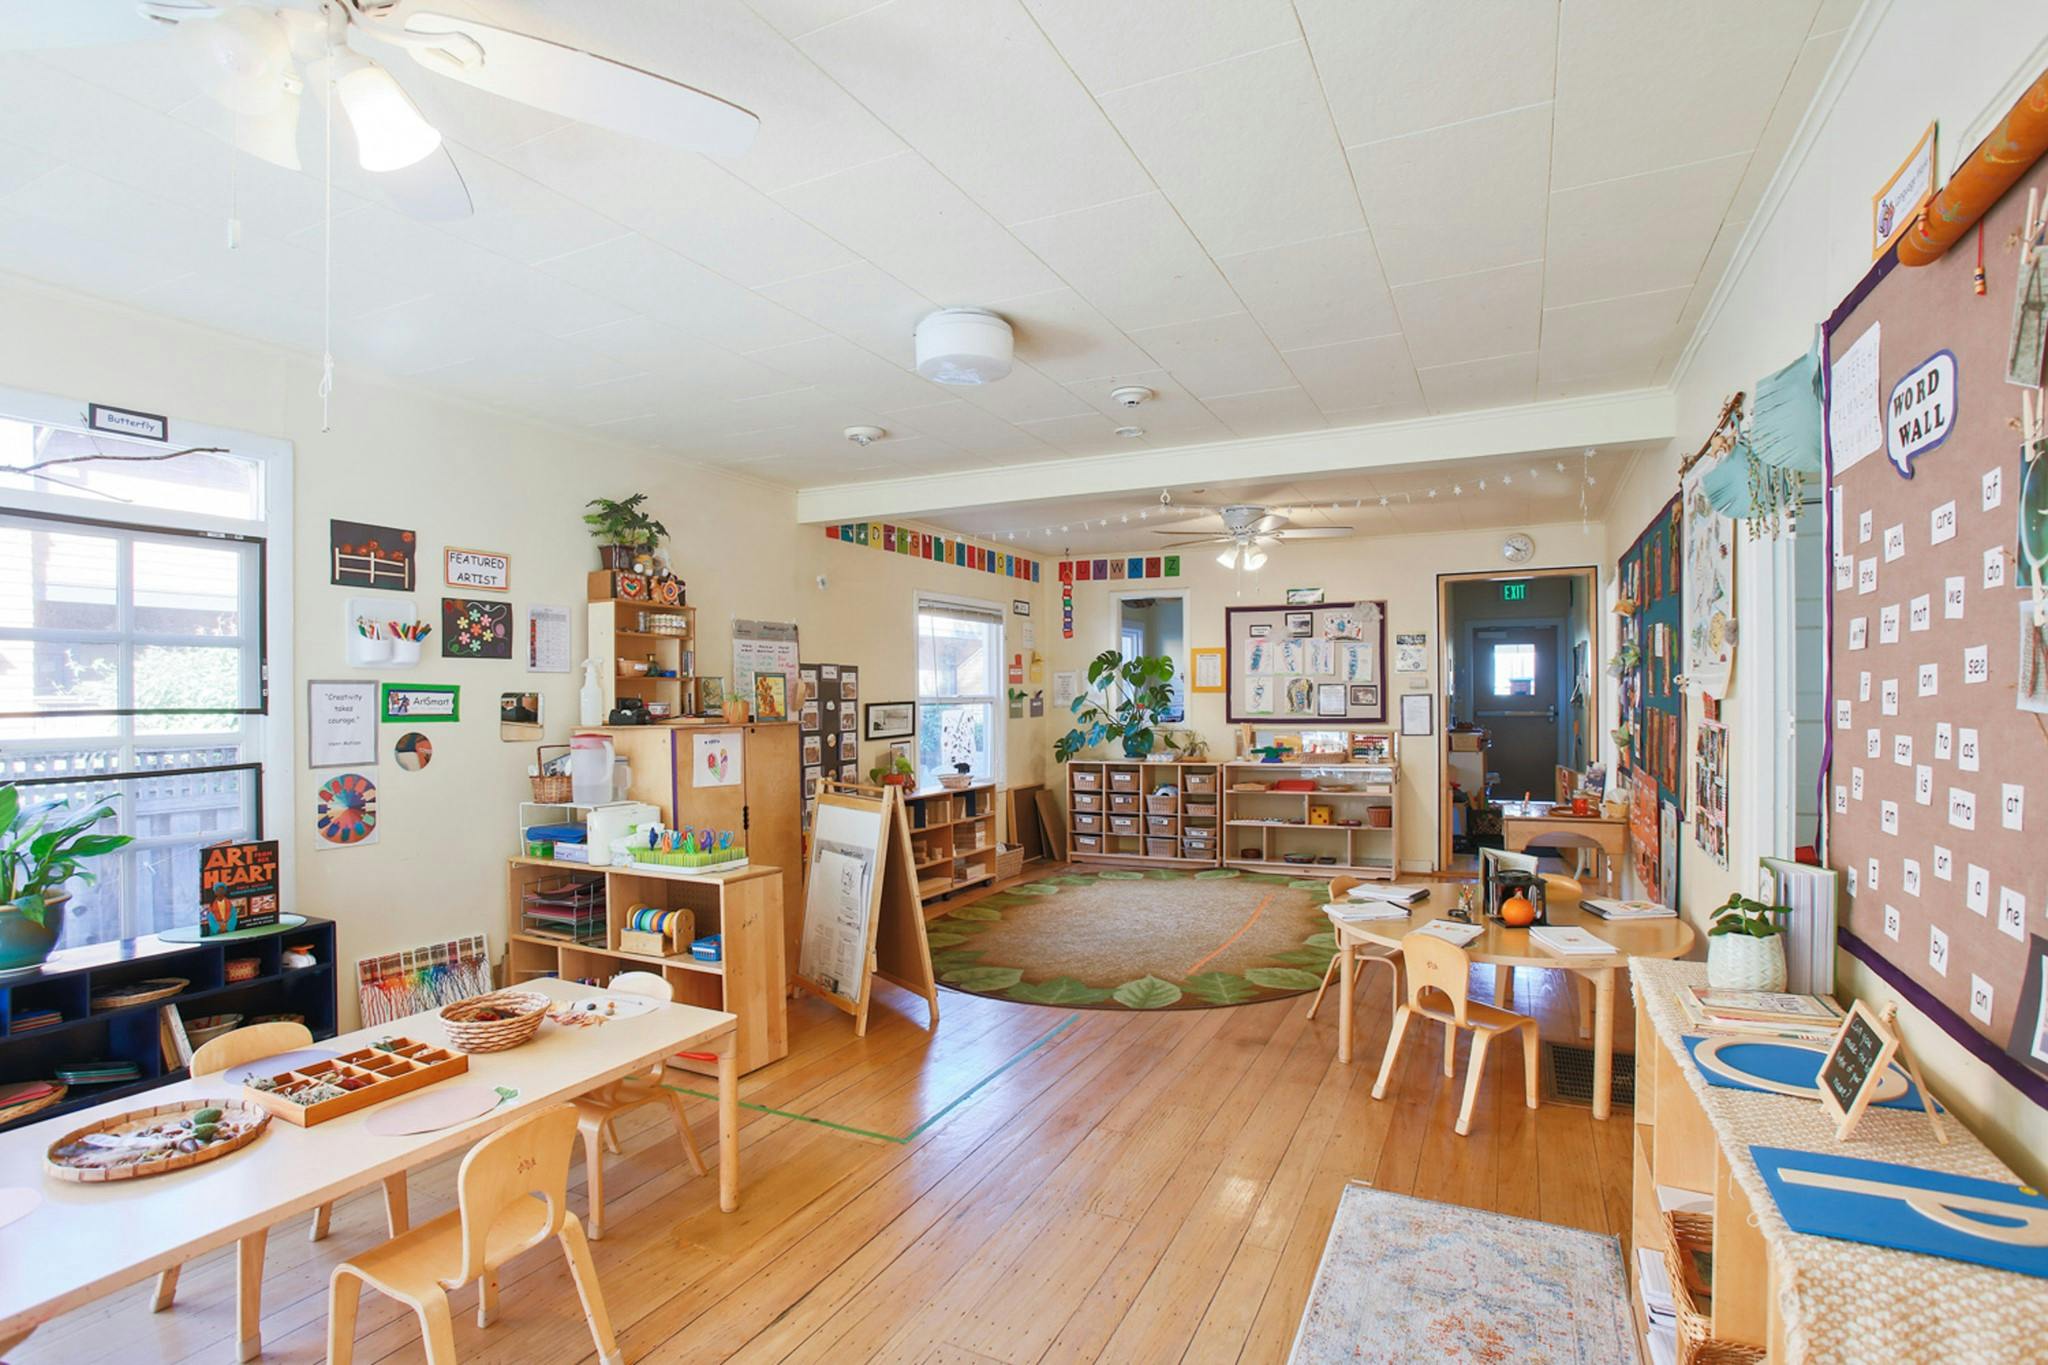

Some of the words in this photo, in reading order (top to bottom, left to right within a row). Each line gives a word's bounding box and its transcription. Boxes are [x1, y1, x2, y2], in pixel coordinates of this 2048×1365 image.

[1893, 368, 1939, 418] WORD
[107, 414, 156, 432] Butterfly
[1899, 403, 1945, 448] WALL
[1985, 474, 1998, 501] of
[1936, 511, 1953, 530] are
[449, 552, 505, 570] FEATURED
[1096, 563, 1105, 574] V
[1111, 562, 1124, 574] W
[1131, 562, 1140, 573] X
[1149, 561, 1157, 573] Y
[1168, 560, 1176, 571] Z
[1986, 559, 2000, 581] do
[456, 572, 498, 586] ARTIST
[1503, 584, 1526, 600] EXIT
[1948, 589, 1961, 604] we
[1913, 606, 1927, 624] not
[1968, 658, 1985, 675] see
[413, 696, 450, 706] ArtSmart
[1938, 731, 1949, 750] to
[1962, 743, 1975, 759] as
[1919, 773, 1929, 793] is
[1952, 796, 1972, 821] into
[2006, 795, 2020, 815] at
[204, 845, 258, 871] ART
[203, 863, 277, 890] HEART
[2005, 897, 2021, 927] he
[1932, 934, 1945, 963] by
